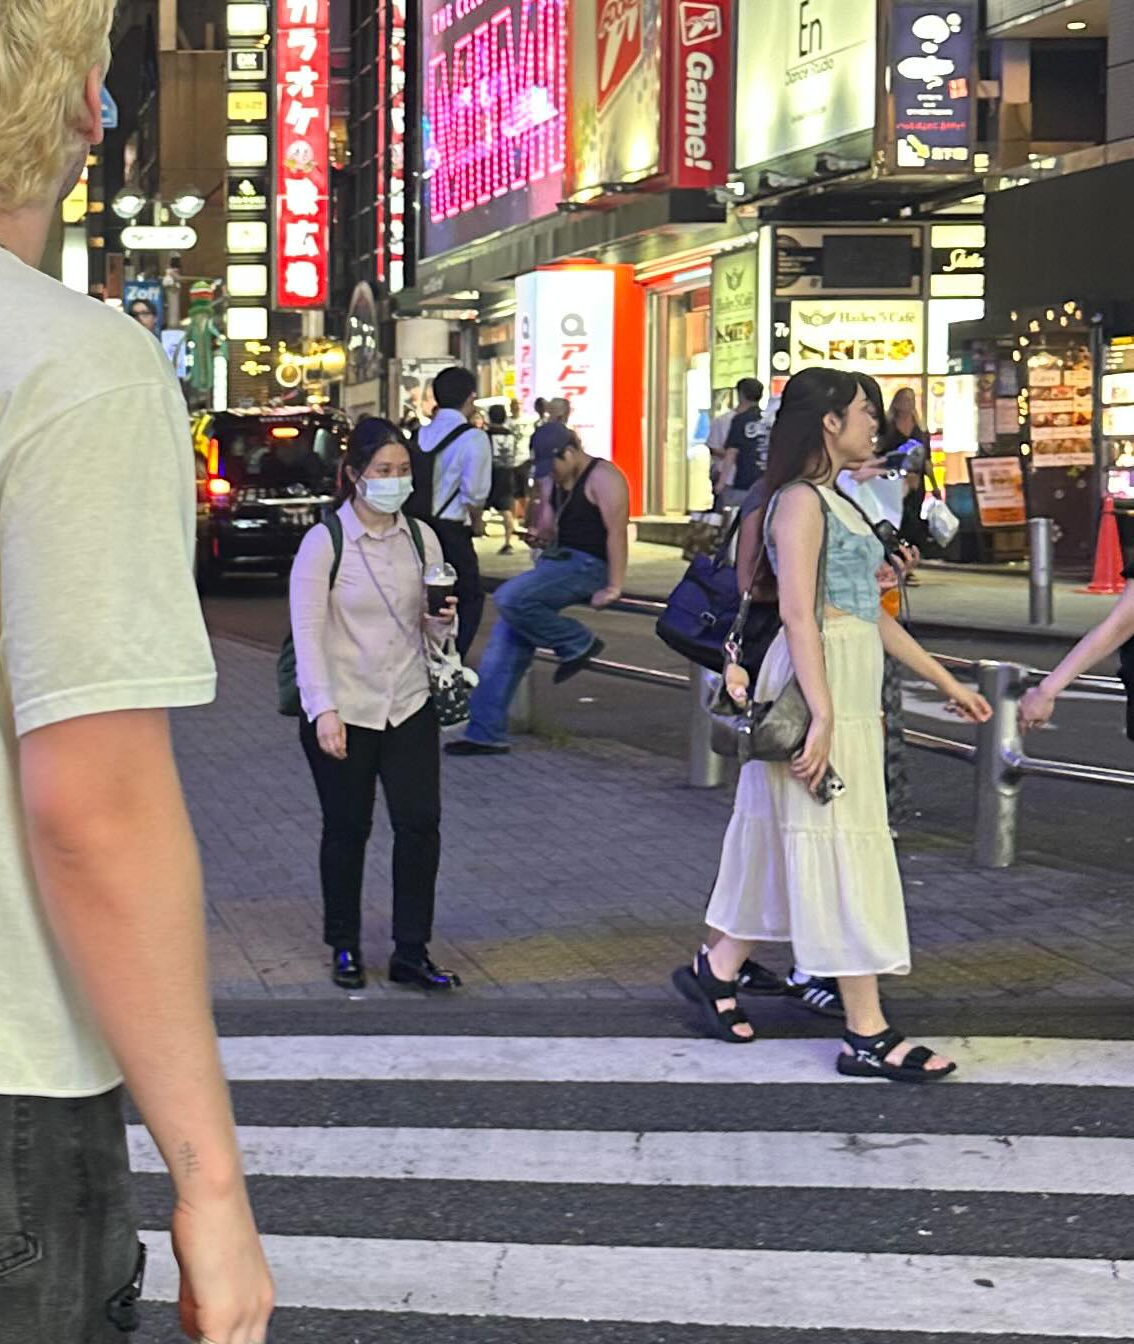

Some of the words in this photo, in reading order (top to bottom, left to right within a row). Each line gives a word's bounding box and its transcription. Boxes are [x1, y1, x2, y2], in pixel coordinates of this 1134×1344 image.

[432, 3, 453, 35] THE
[684, 51, 715, 172] Game!
[126, 285, 161, 301] Zoff
